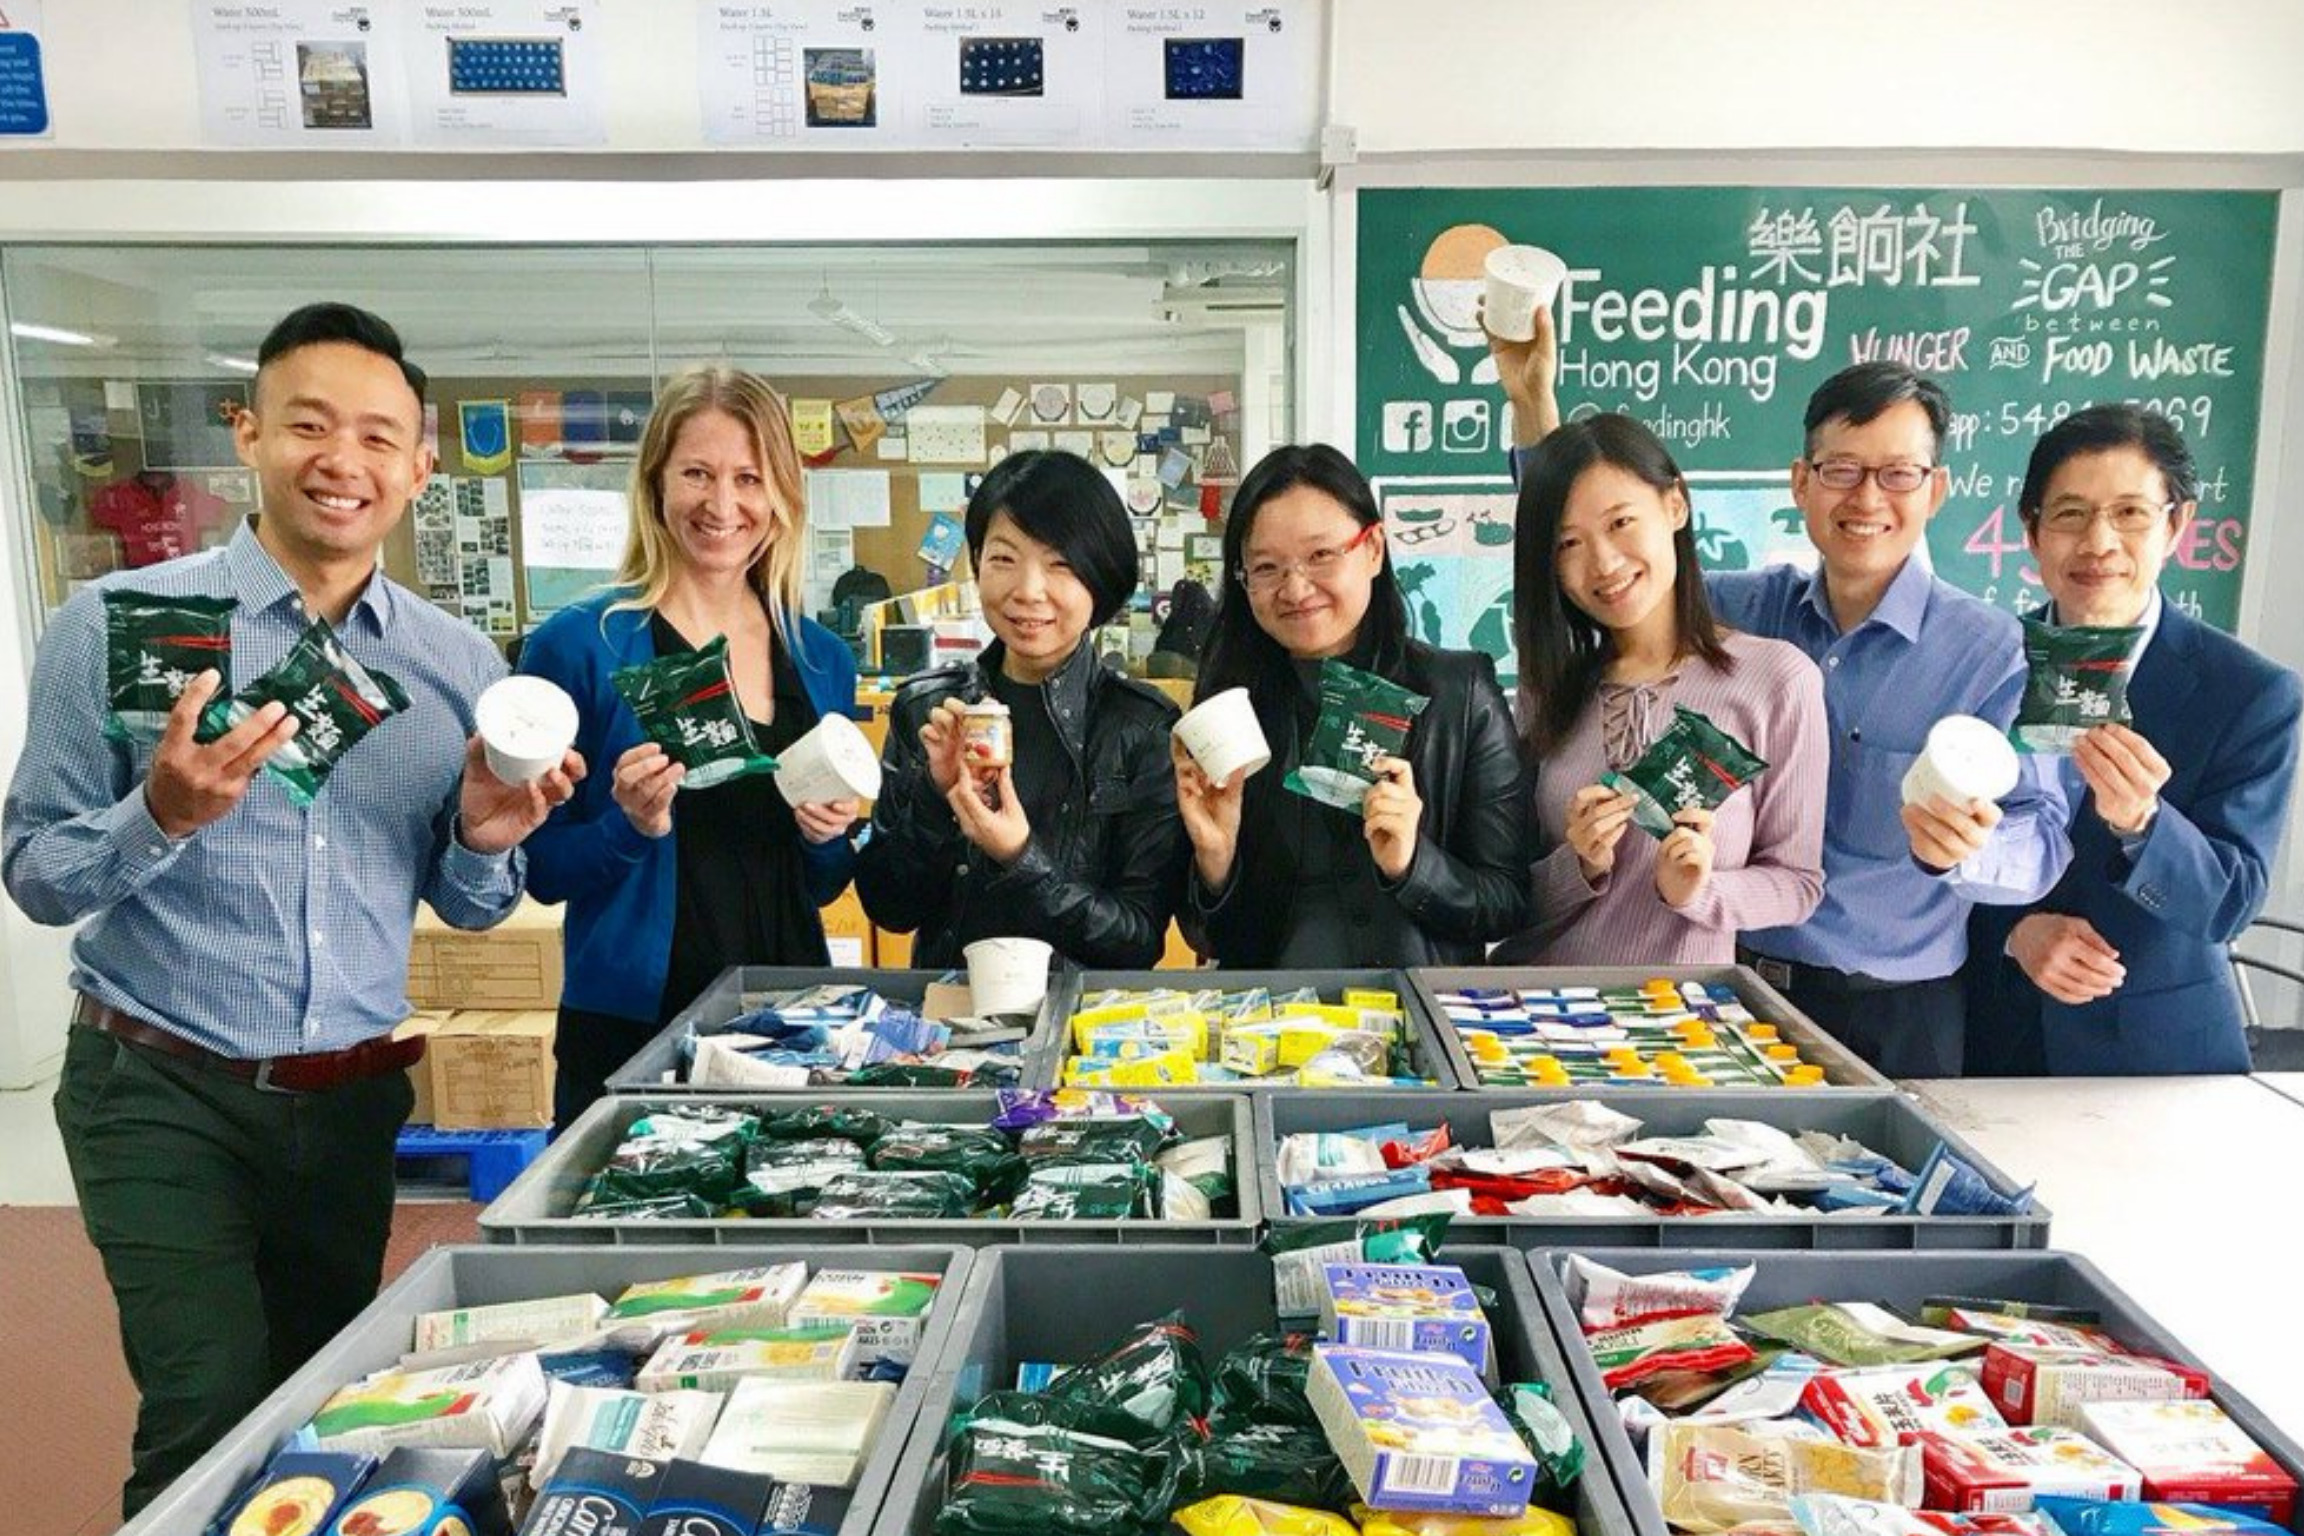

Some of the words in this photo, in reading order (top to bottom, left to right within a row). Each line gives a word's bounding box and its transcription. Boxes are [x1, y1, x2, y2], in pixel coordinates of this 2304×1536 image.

[1749, 202, 1981, 287] 樂餉社
[2036, 198, 2168, 252] Bridging
[2055, 243, 2085, 260] THE
[2040, 263, 2140, 311] GAP
[1560, 266, 1828, 360] Feeding
[2025, 310, 2161, 332] between
[1559, 349, 1659, 399] Hong
[1672, 343, 1778, 398] Kong
[1990, 346, 2030, 364] AND
[2043, 336, 2114, 384] FOOD
[2129, 338, 2236, 380] WASTE
